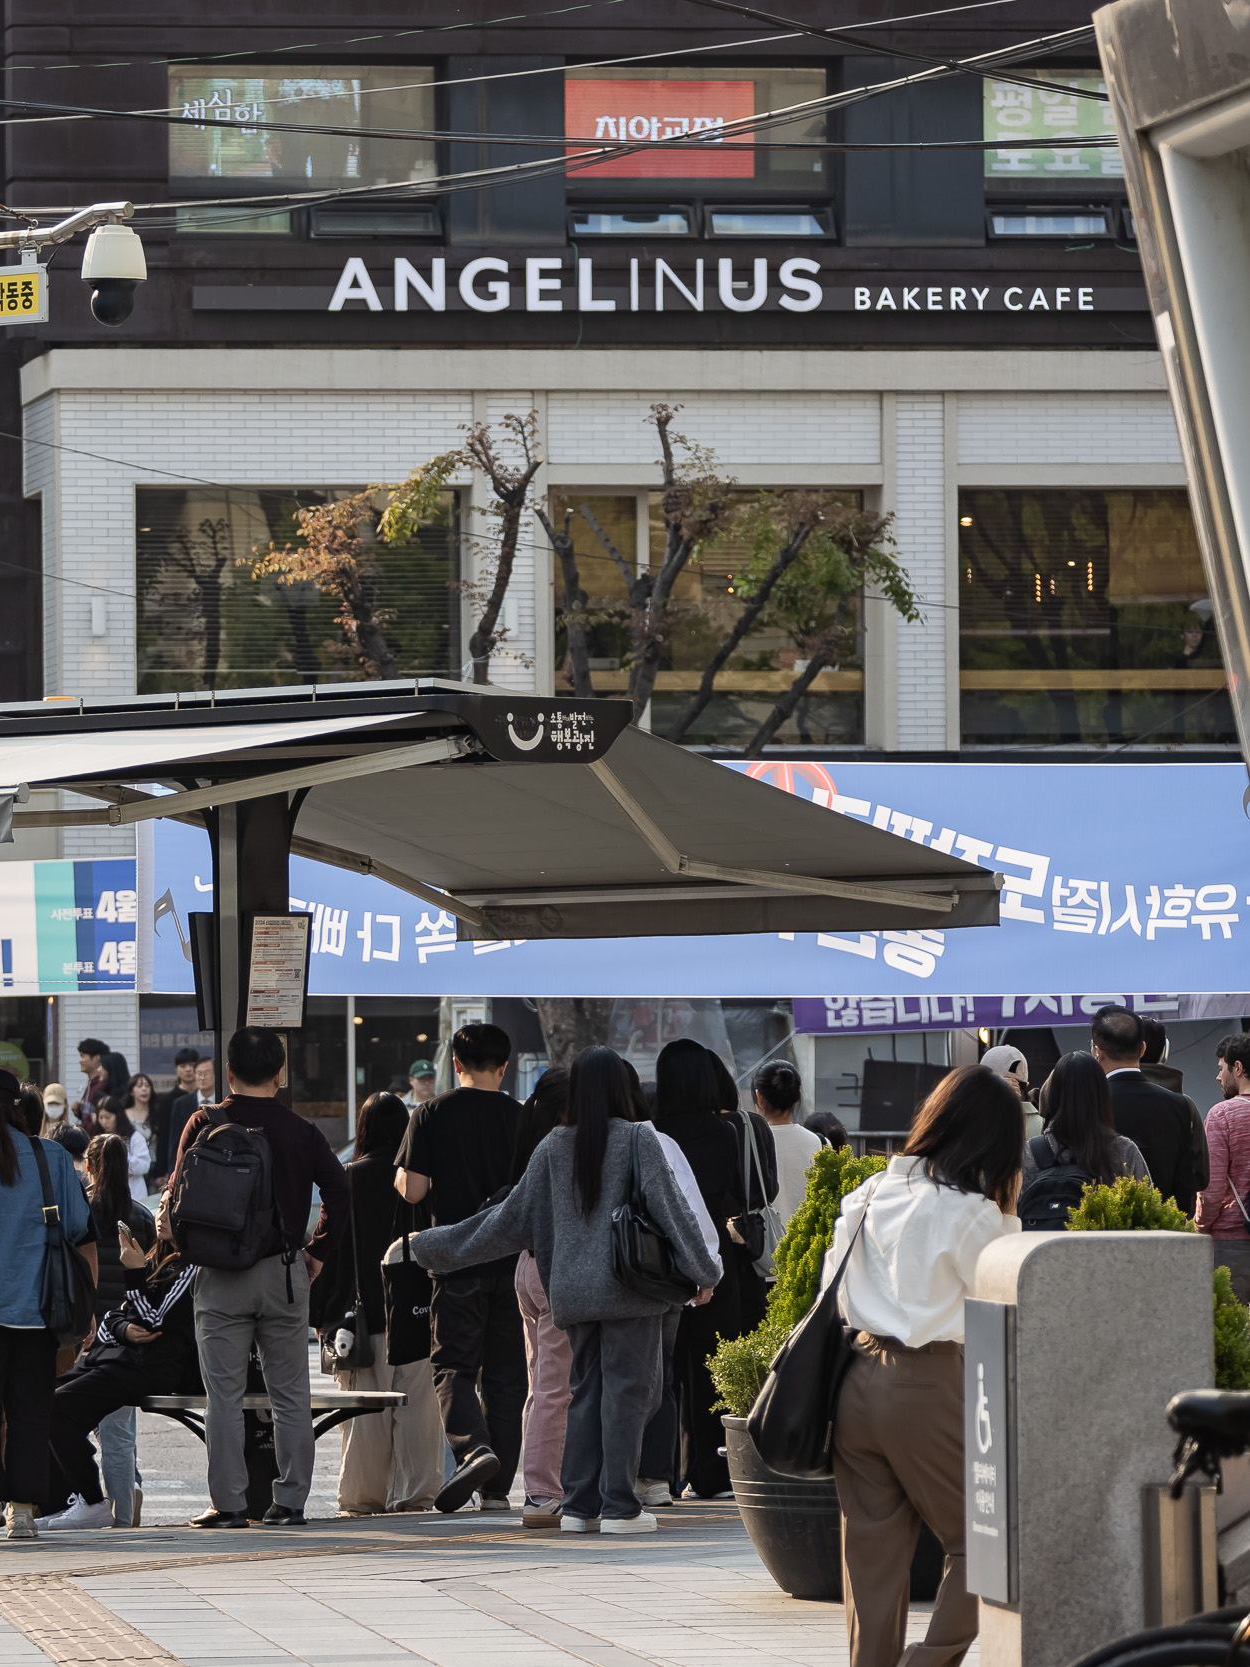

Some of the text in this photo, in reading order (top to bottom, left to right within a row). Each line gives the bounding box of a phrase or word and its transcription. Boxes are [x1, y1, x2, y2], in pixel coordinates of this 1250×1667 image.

[329, 257, 1094, 312] ANGELINUS BAKERY CAFE
[550, 727, 595, 751] 행복광진
[50, 906, 95, 921] 사전투표
[62, 961, 96, 976] 본투표
